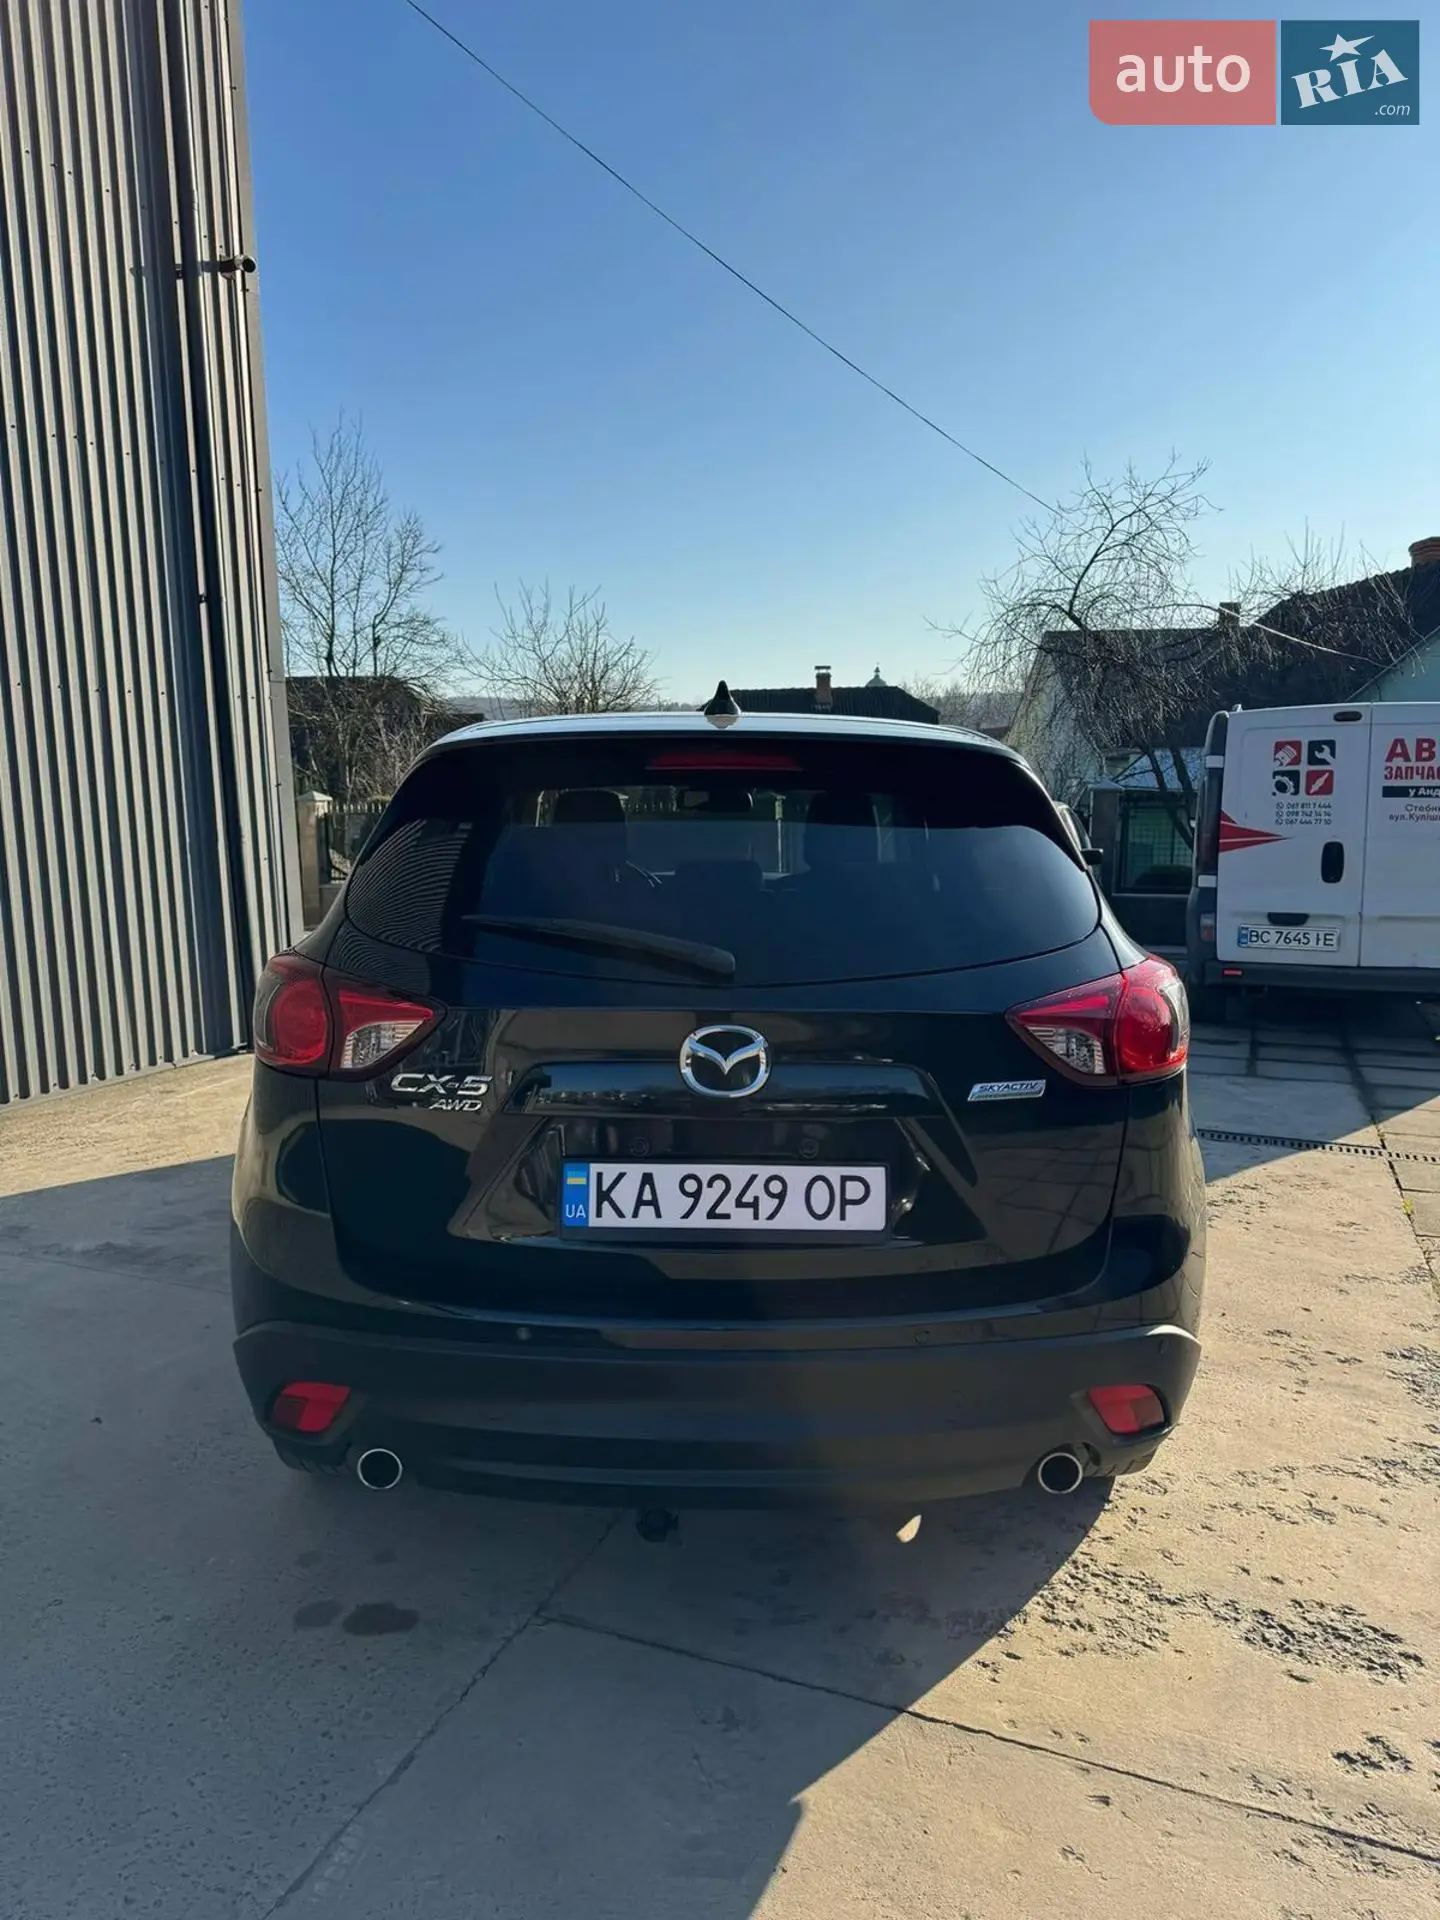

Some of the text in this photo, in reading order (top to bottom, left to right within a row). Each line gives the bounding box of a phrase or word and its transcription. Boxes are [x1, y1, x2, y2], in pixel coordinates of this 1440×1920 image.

[1249, 930, 1271, 943] BC
[1275, 931, 1311, 945] 7645
[391, 1073, 493, 1095] CX-5
[979, 1082, 1039, 1092] SKYACTIV
[428, 1099, 482, 1111] AWD
[595, 1171, 871, 1221] KA 9249 OP
[565, 1204, 586, 1218] UA
